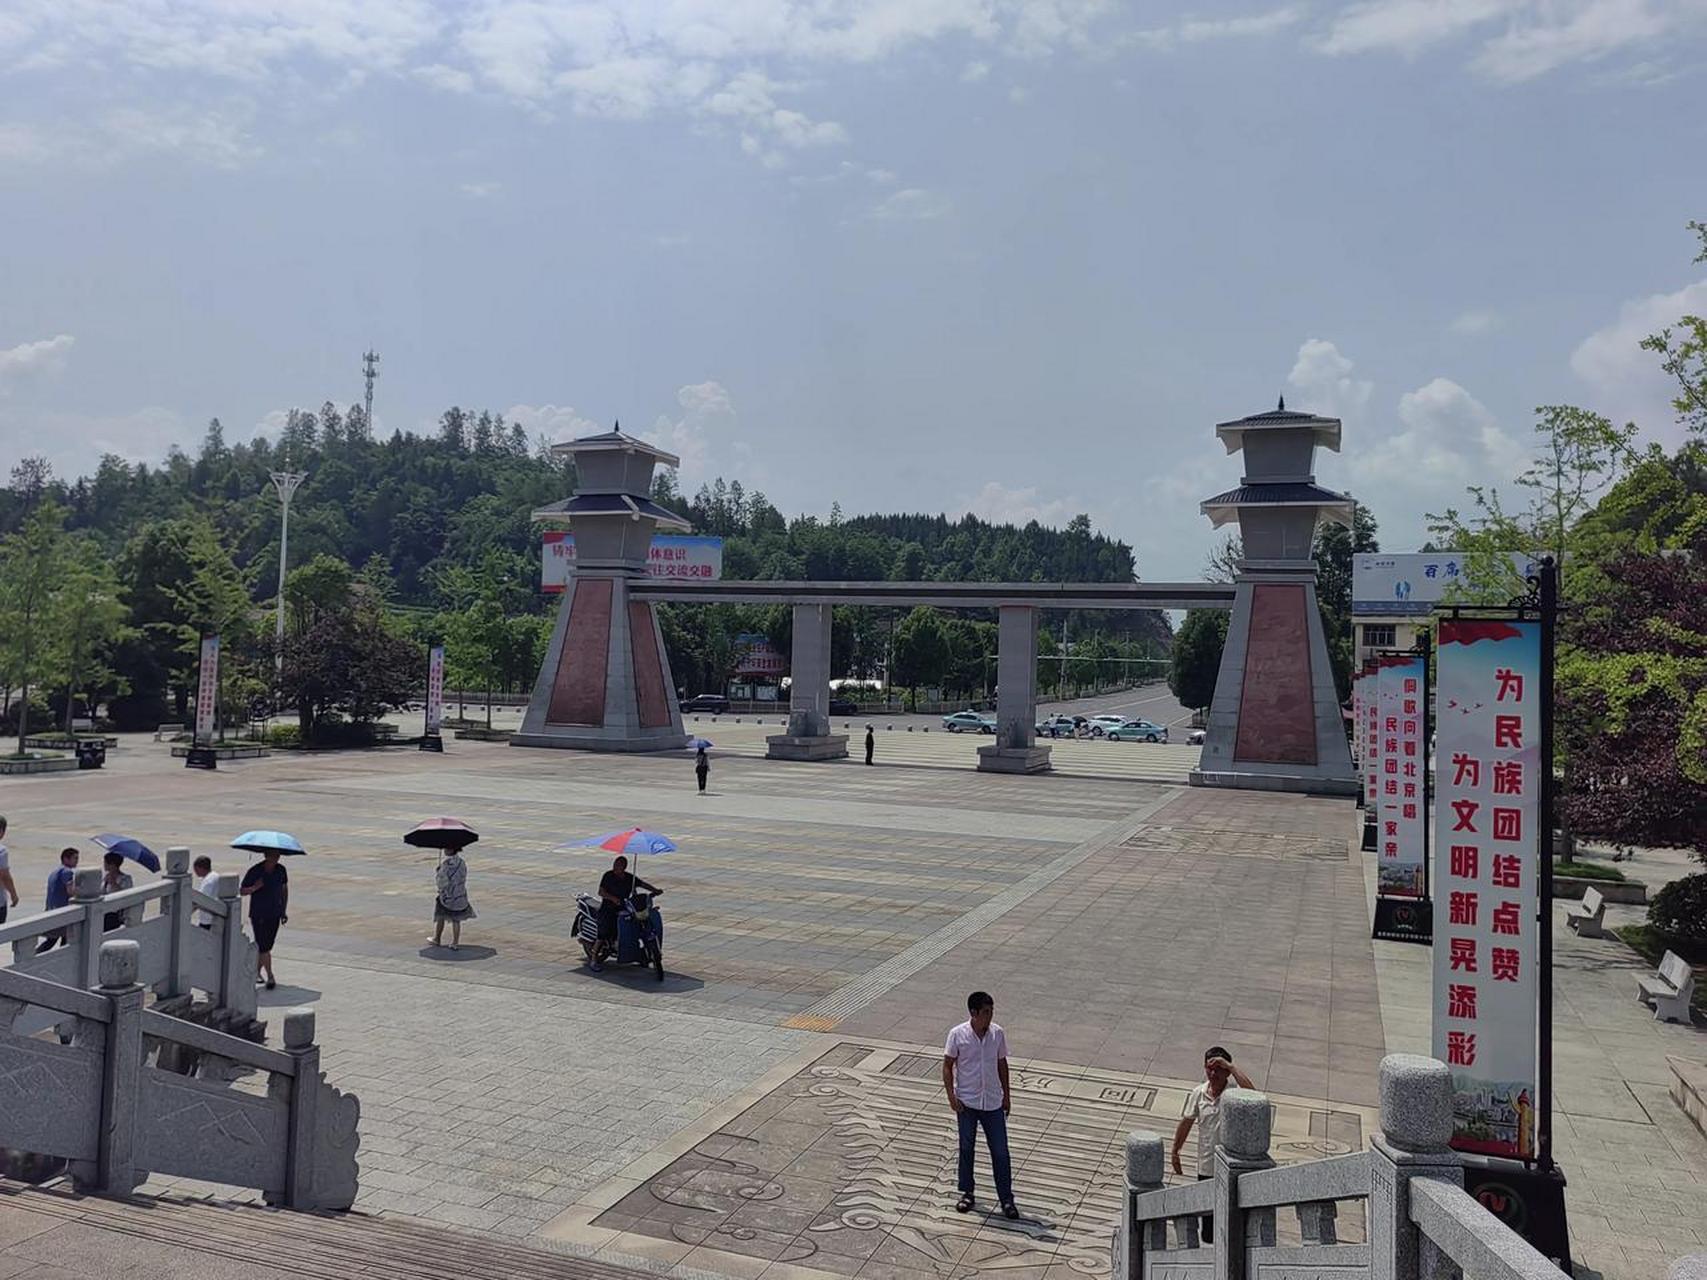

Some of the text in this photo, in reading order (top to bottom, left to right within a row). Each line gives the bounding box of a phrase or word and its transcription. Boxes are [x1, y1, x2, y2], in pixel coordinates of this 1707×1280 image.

[646, 547, 686, 560] 体意识
[1384, 716, 1398, 858] 民族团结一家亲
[1491, 668, 1524, 982] 为民族团结点赞
[1447, 752, 1480, 1067] 为文明新晃添彩
